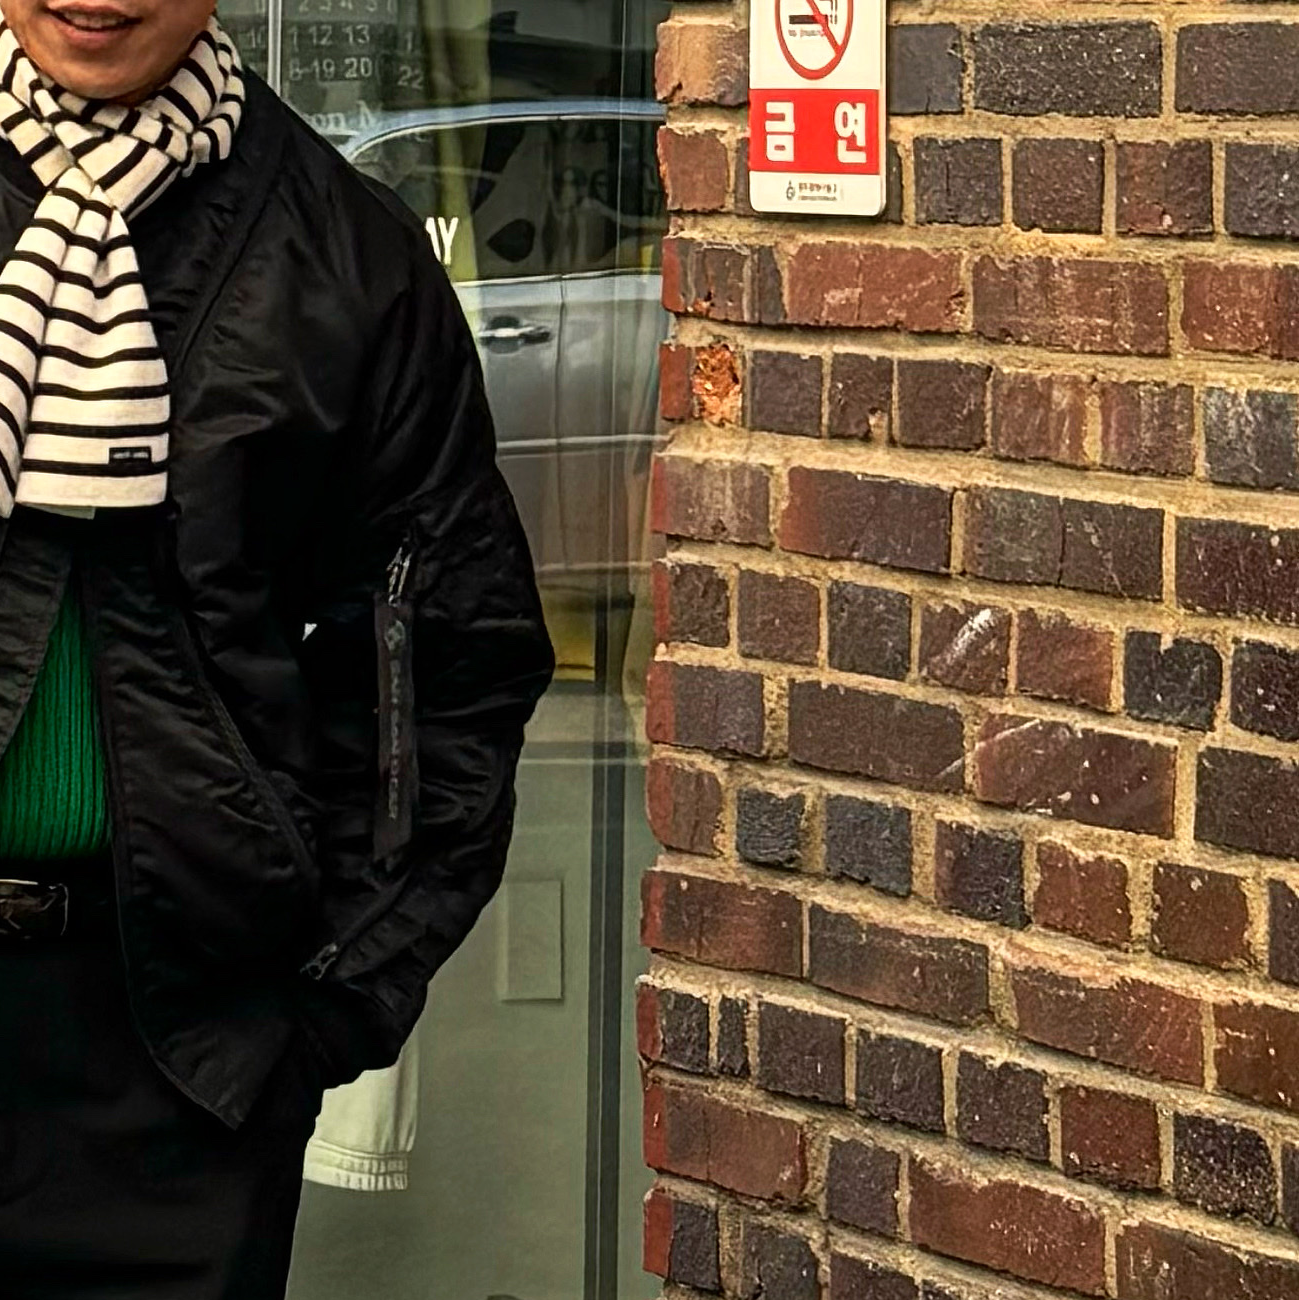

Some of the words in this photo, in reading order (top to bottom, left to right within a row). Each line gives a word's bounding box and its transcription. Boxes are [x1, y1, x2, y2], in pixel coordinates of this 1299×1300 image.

[308, 24, 333, 46] 12
[342, 24, 371, 45] 13
[343, 56, 373, 78] 20
[764, 100, 867, 164] 금연
